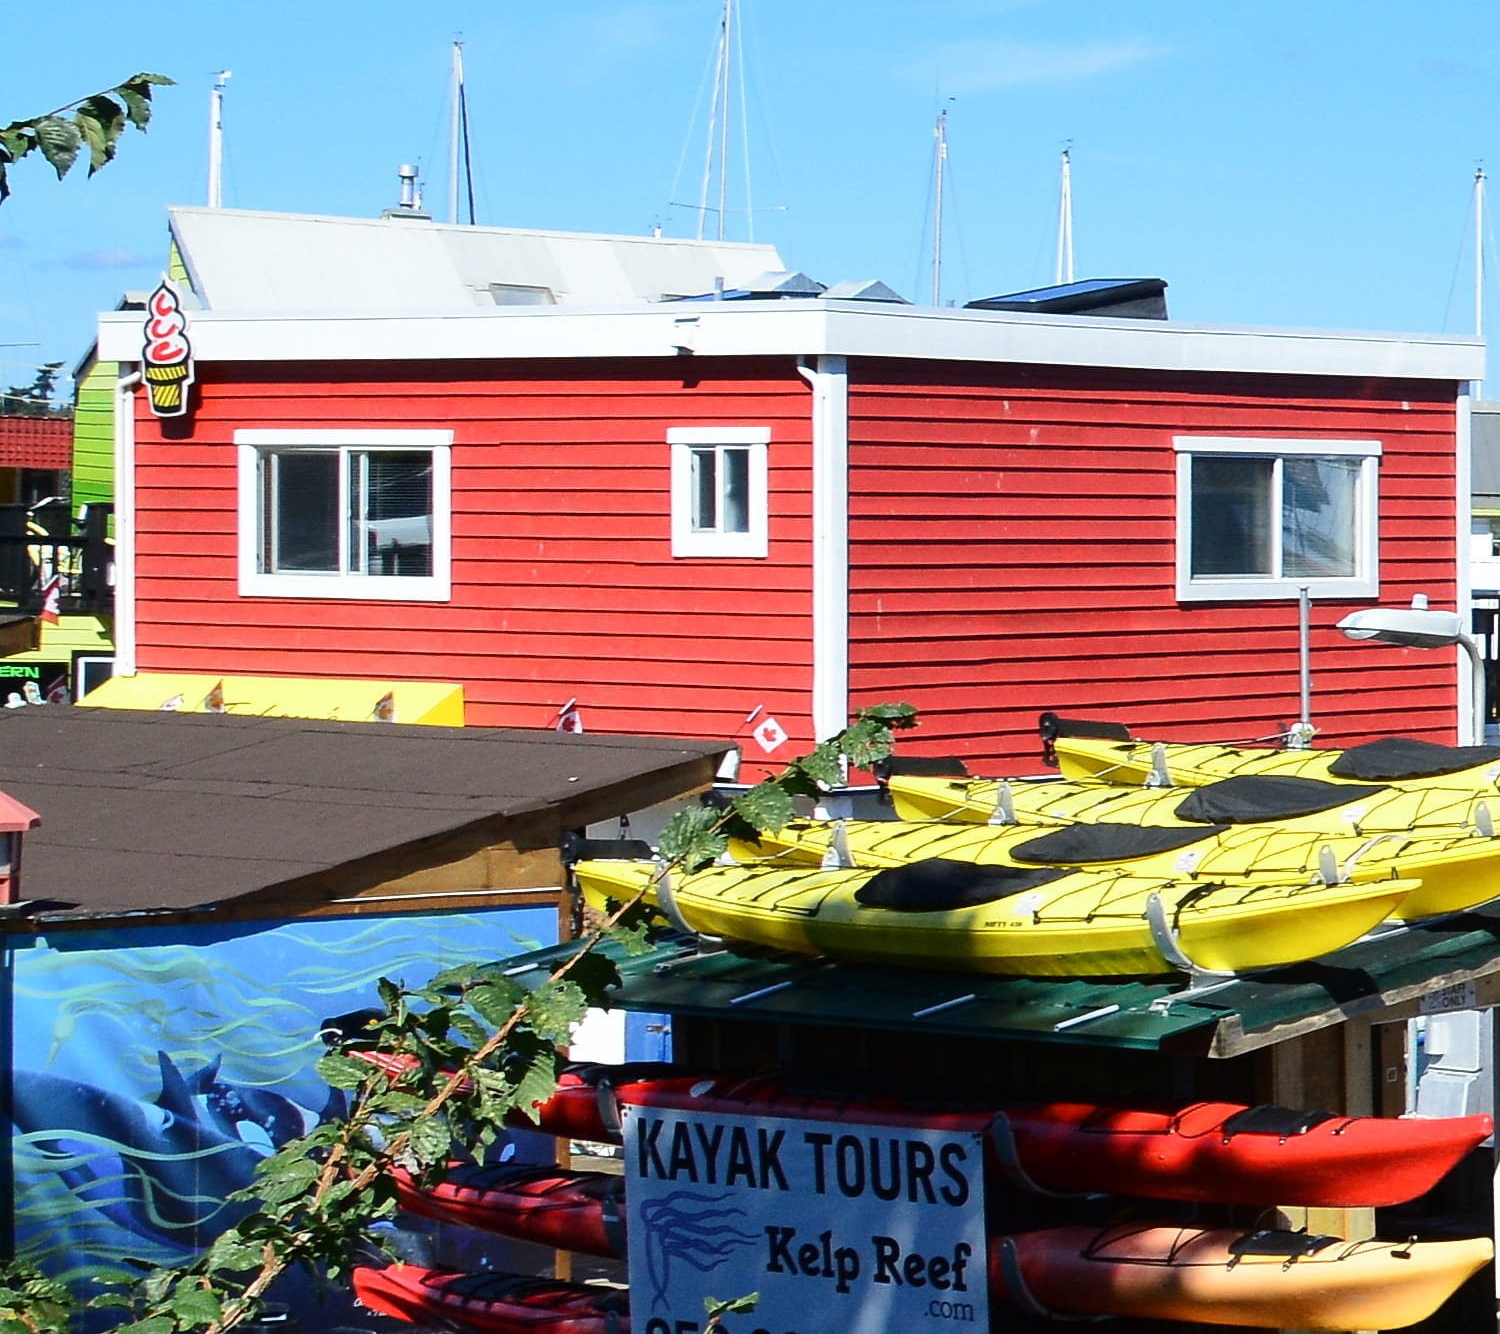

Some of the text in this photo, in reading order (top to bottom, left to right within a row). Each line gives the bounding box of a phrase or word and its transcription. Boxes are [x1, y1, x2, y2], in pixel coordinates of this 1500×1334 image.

[637, 1116, 971, 1208] KAYAK TOURS
[764, 1225, 973, 1295] Kelp Reef
[923, 1297, 975, 1324] .com
